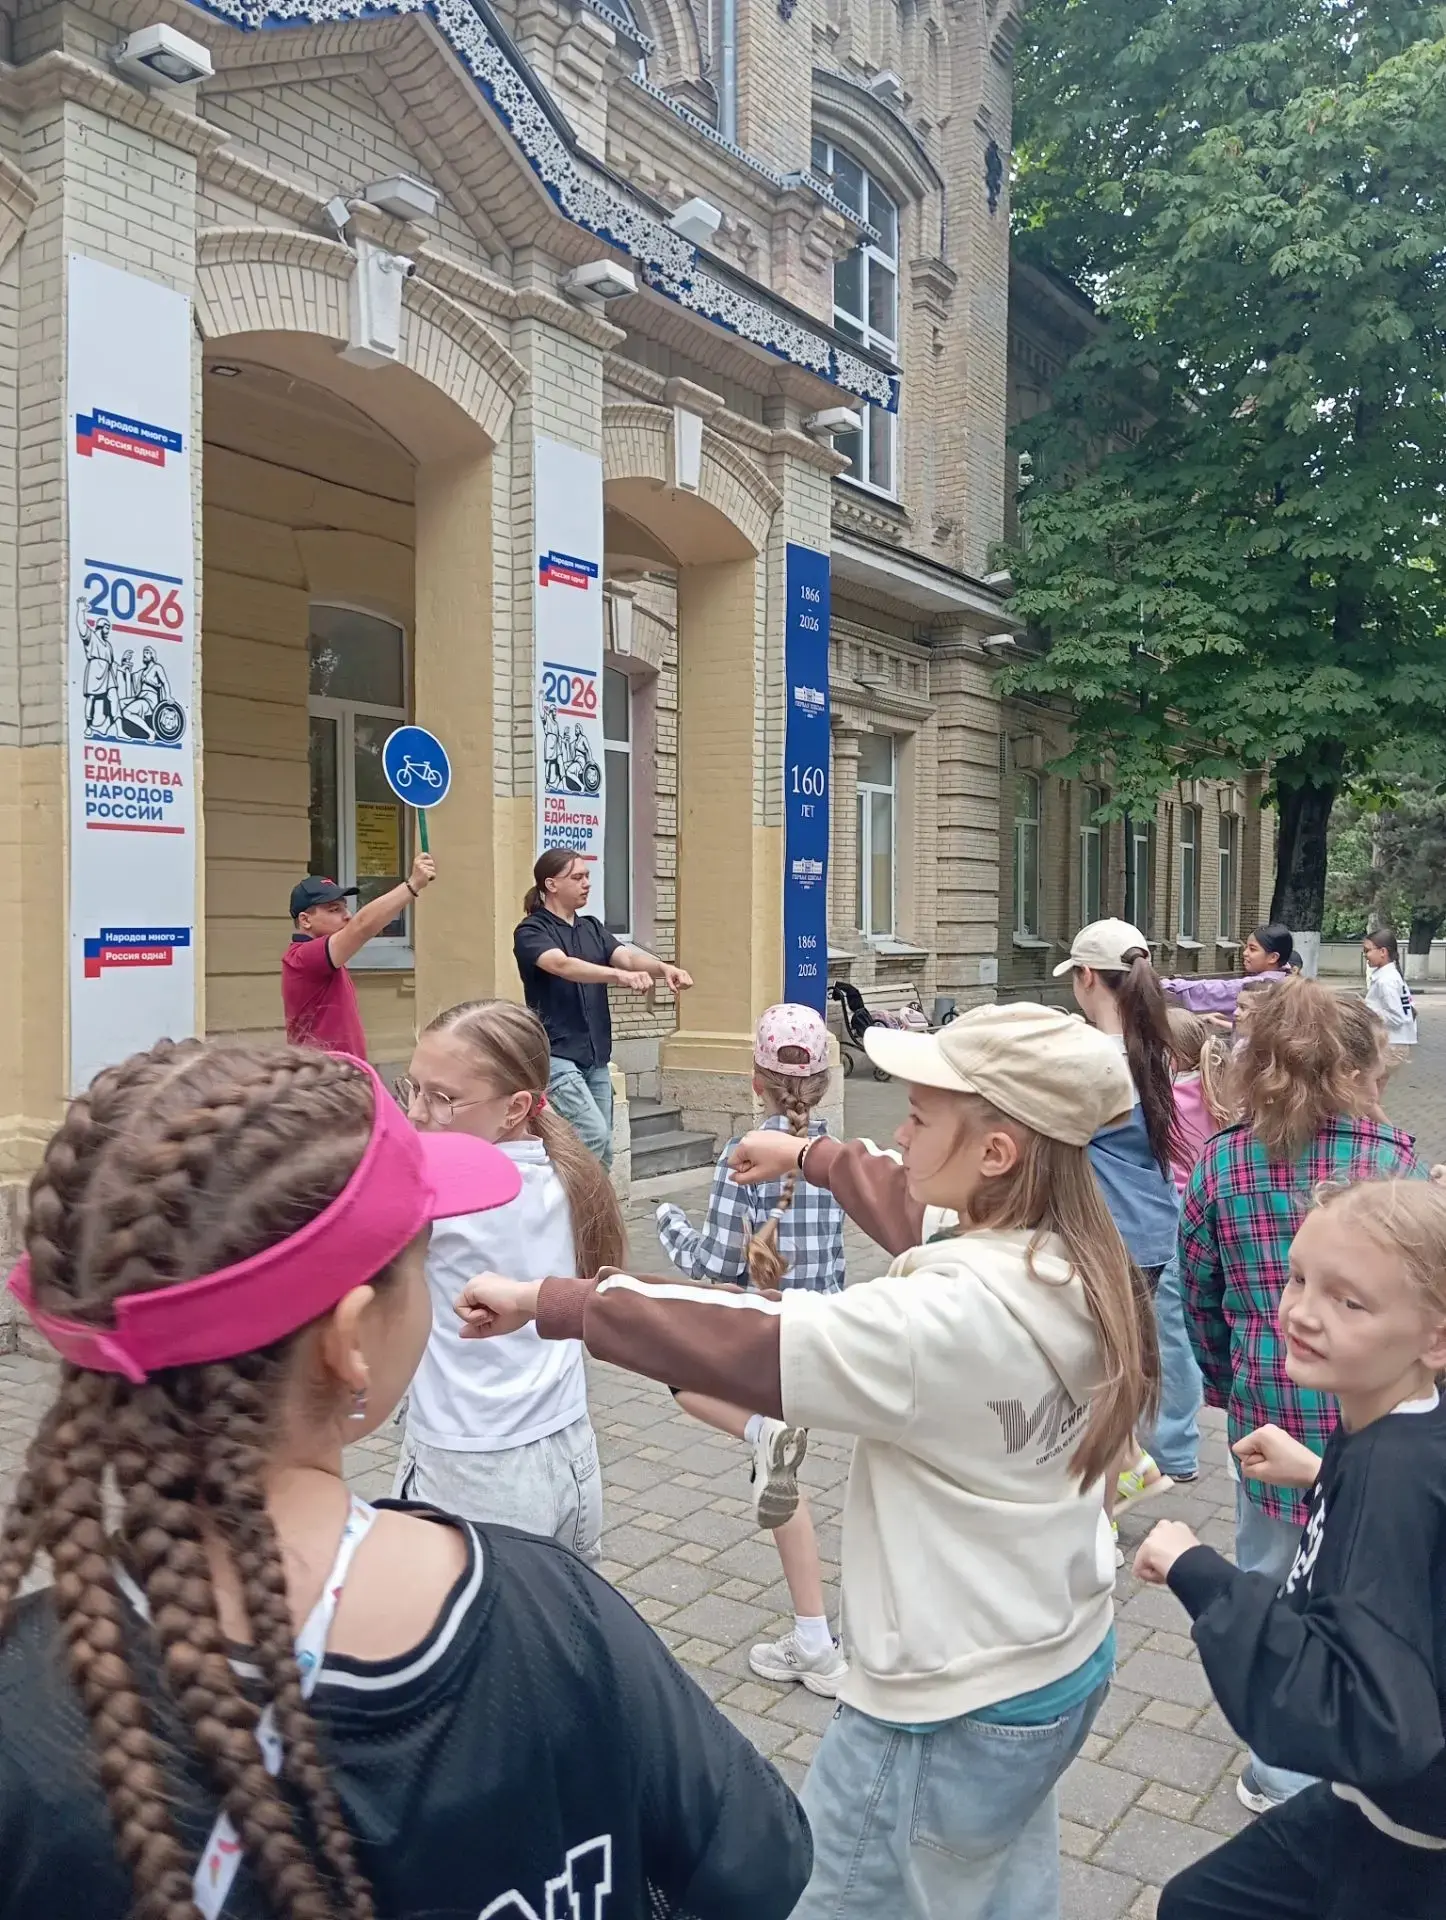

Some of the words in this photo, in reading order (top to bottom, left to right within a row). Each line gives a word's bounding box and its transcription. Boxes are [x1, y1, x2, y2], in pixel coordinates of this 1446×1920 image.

[97, 414, 139, 435] Народов
[140, 429, 168, 443] много
[97, 434, 132, 451] Россия
[133, 446, 159, 459] одна!
[551, 555, 574, 568] Народов
[574, 562, 590, 572] много
[550, 569, 570, 581] Россия
[83, 572, 184, 630] 2026
[800, 585, 820, 603] 1866
[799, 614, 819, 632] 2026
[542, 671, 597, 710] 2026
[84, 745, 121, 766] ГОД
[84, 764, 183, 787] ЕДИНСТВА
[791, 764, 825, 797] 160
[85, 783, 174, 804] НАРОДОВ
[85, 802, 163, 821] РОССИИ
[544, 797, 566, 812] ГОД
[801, 804, 815, 818] ЛЕТ
[544, 810, 599, 826] ЕДИНСТВА
[544, 825, 593, 839] НАРОДОВ
[544, 838, 587, 852] РОССИИ
[105, 932, 147, 943] Народов
[797, 935, 817, 949] 1866
[105, 951, 140, 961] Россия
[141, 951, 167, 961] одна!
[798, 963, 817, 977] 2026
